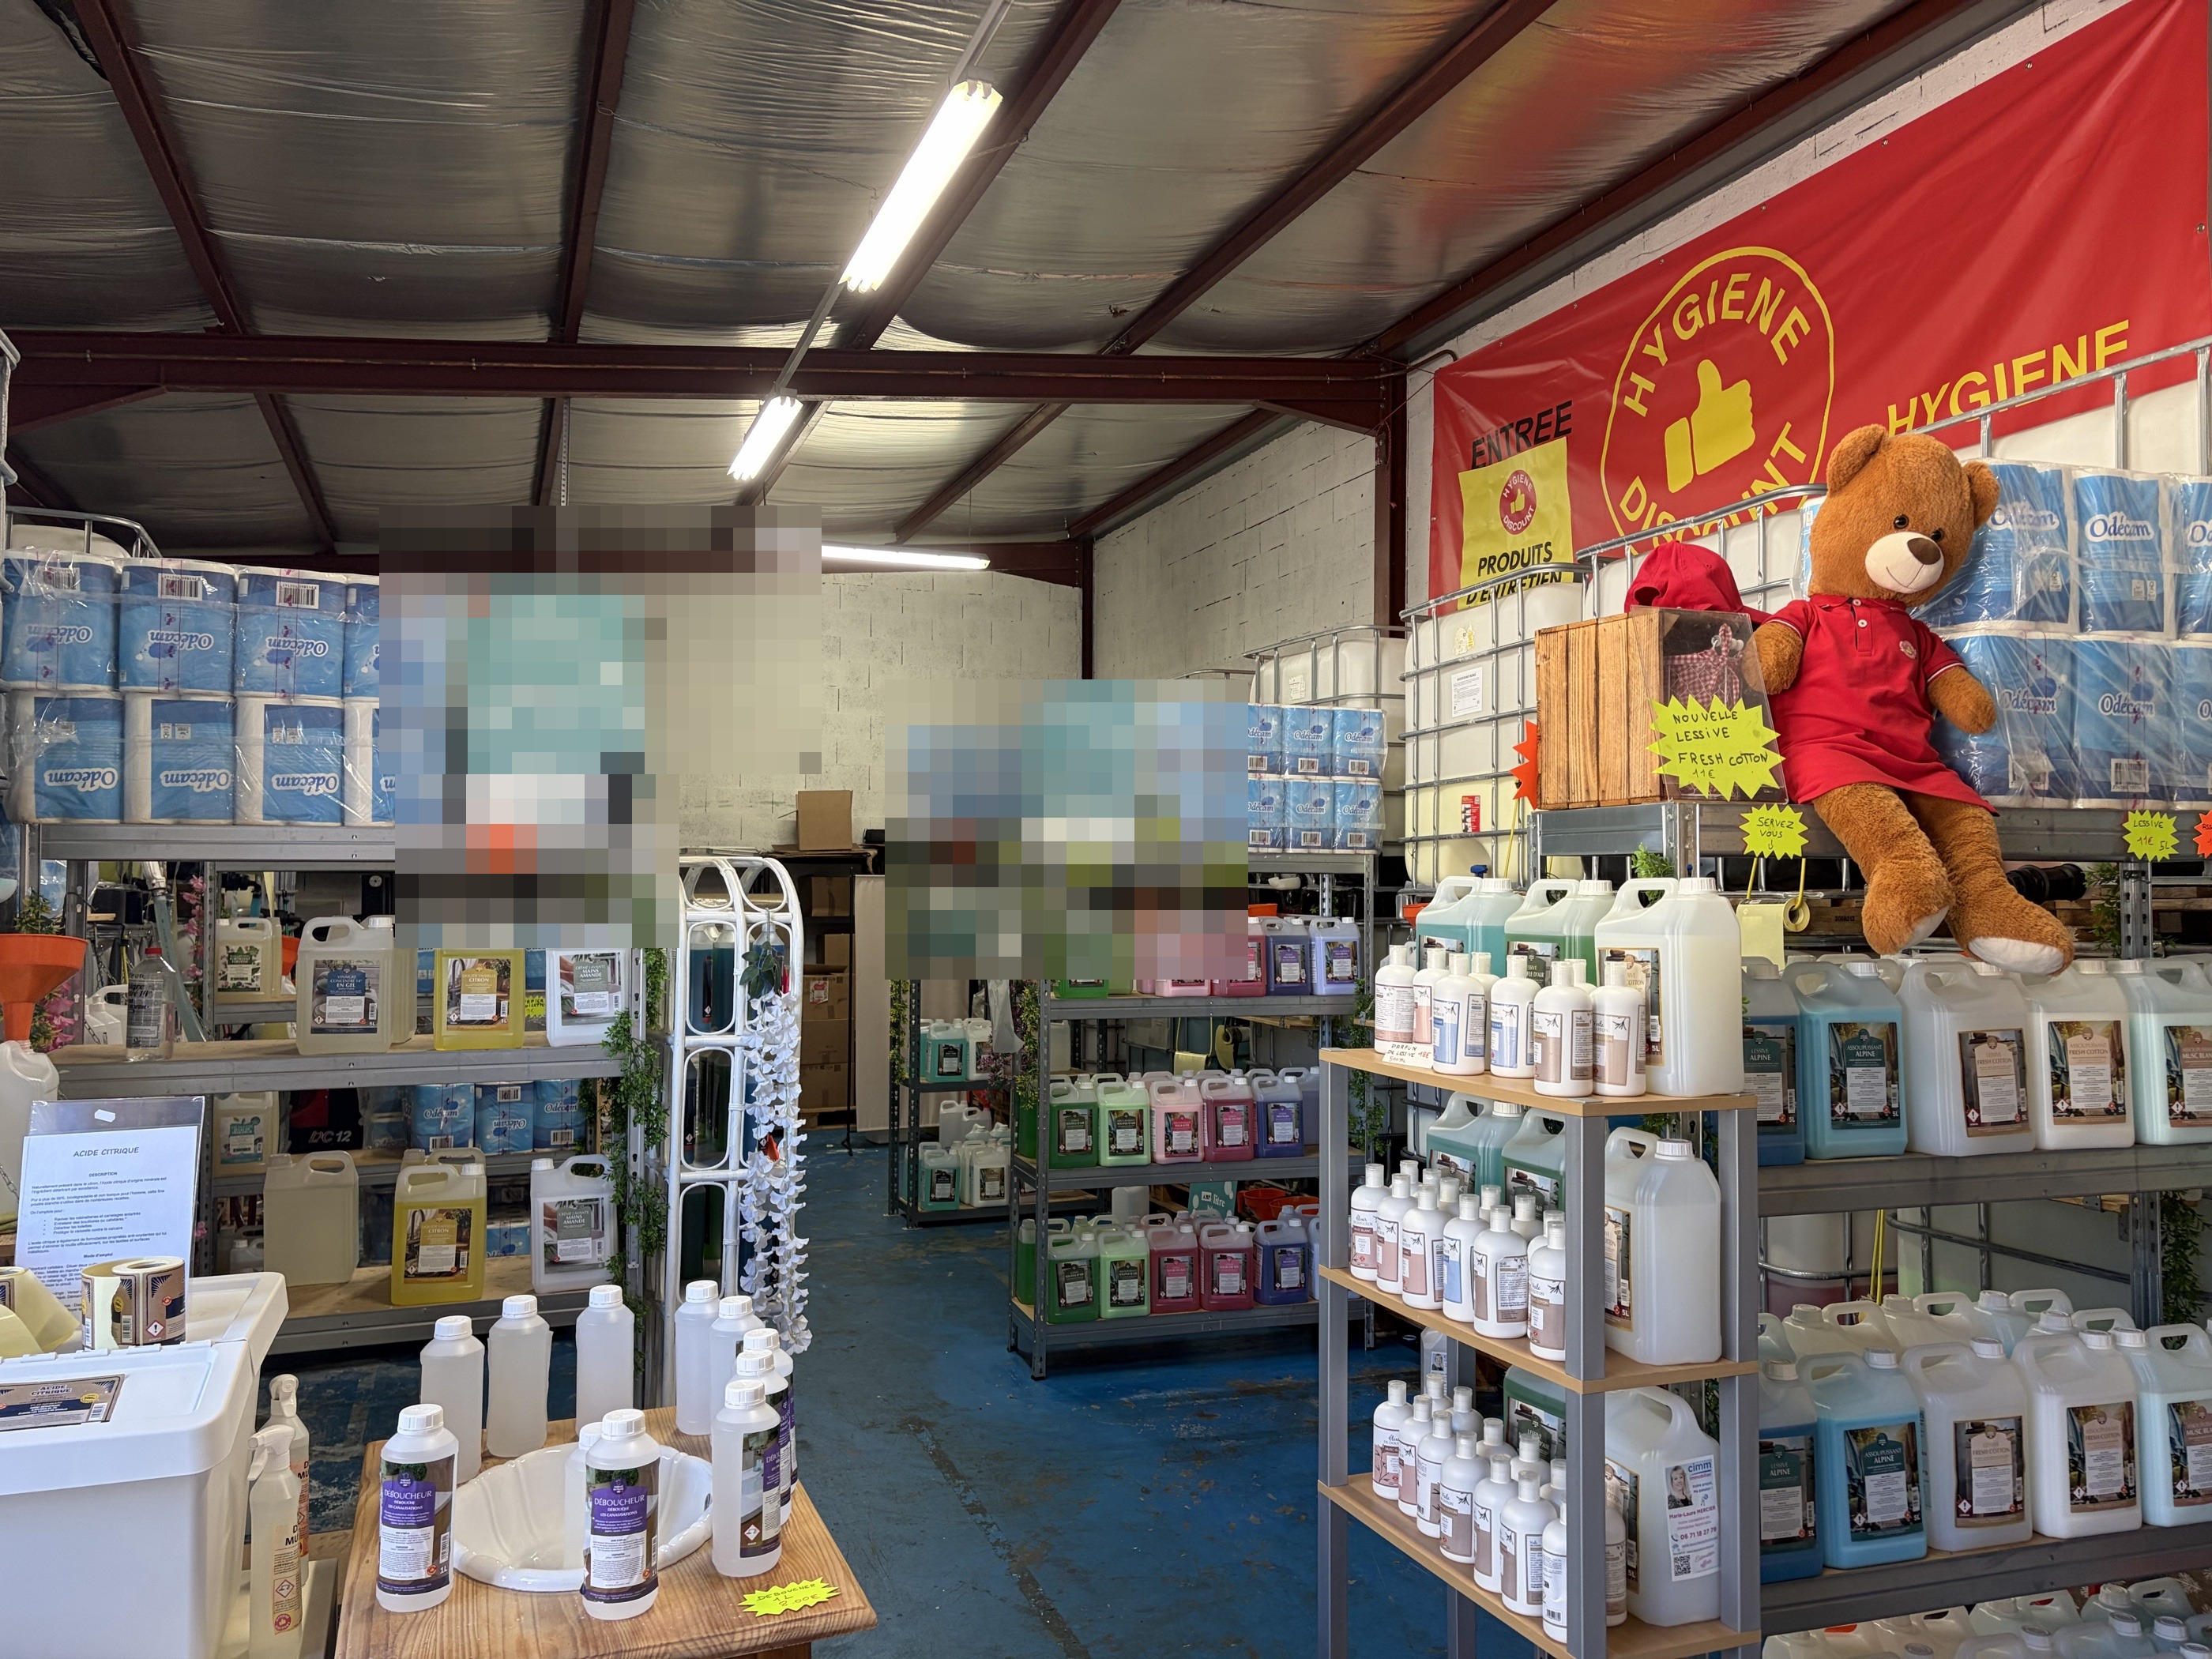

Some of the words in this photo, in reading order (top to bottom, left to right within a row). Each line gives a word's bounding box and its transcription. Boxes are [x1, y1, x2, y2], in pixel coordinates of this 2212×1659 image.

[1623, 273, 1811, 418] HYGIENE
[1471, 400, 1572, 470] ENTREE
[1503, 473, 1533, 498] HYGIENE
[1503, 504, 1535, 531] DISCOUNT
[2090, 514, 2151, 537] Odécam
[1477, 541, 1553, 577] PRODUITS
[2101, 694, 2154, 715] Odécam
[1672, 710, 1738, 724] NOUVELLE
[1295, 730, 1322, 740] Odécam
[1345, 733, 1373, 743] Odécam
[1678, 752, 1724, 766] FRESH
[1729, 752, 1768, 766] COTTON
[162, 769, 230, 791] Odécam
[1693, 769, 1716, 778] 11€
[273, 773, 339, 795] Odécam
[1297, 803, 1325, 813] Odécam
[1756, 817, 1794, 830] SERVEZ
[2137, 836, 2154, 846] 11€
[2159, 841, 2170, 851] 5L
[308, 1130, 334, 1143] DC
[336, 1130, 352, 1142] 12
[1213, 1194, 1225, 1208] litre
[1874, 1455, 1894, 1464] ALPINE
[1687, 1461, 1712, 1473] cimm
[384, 1489, 432, 1500] DÉBOUCHEUR
[594, 1494, 645, 1507] DÉBOUCHEUR
[1668, 1510, 1696, 1519] Marie-Laure
[1697, 1505, 1716, 1514] MERCIER
[440, 1565, 448, 1574] 1L
[756, 1583, 815, 1601] DEBOUCHER
